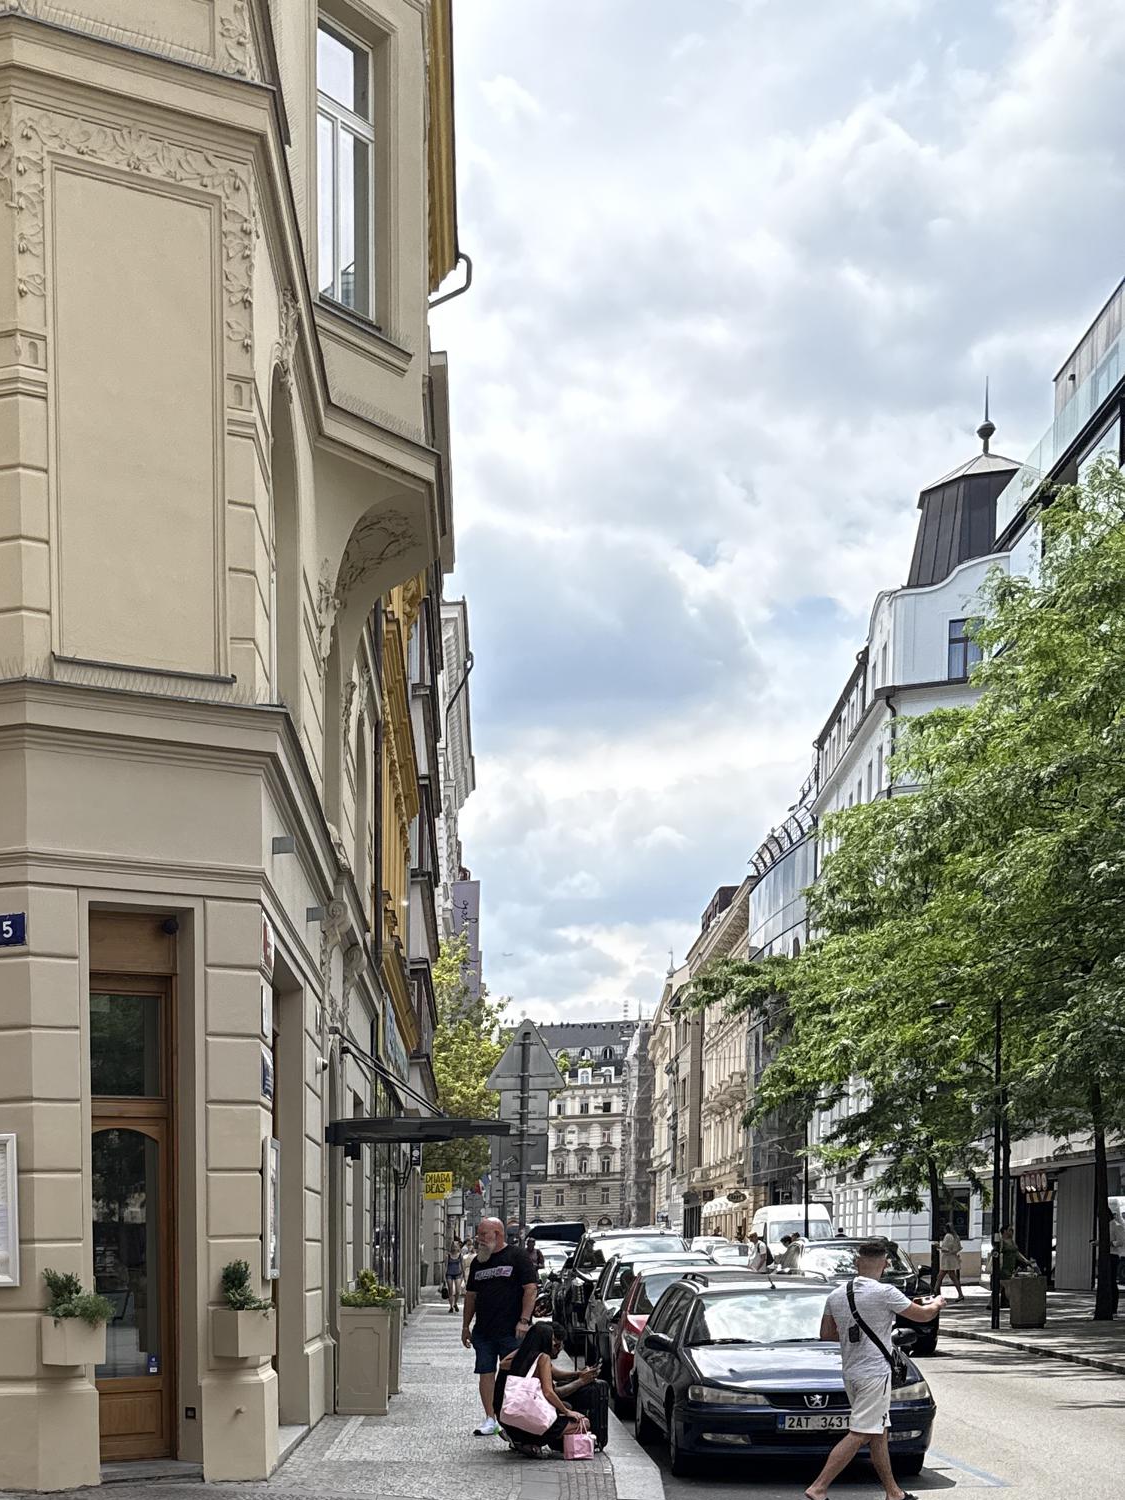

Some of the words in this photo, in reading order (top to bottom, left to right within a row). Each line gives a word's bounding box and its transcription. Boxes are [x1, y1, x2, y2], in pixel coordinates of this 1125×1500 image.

[2, 920, 14, 938] 5
[787, 1416, 811, 1428] 2AT
[820, 1416, 850, 1428] 3431
